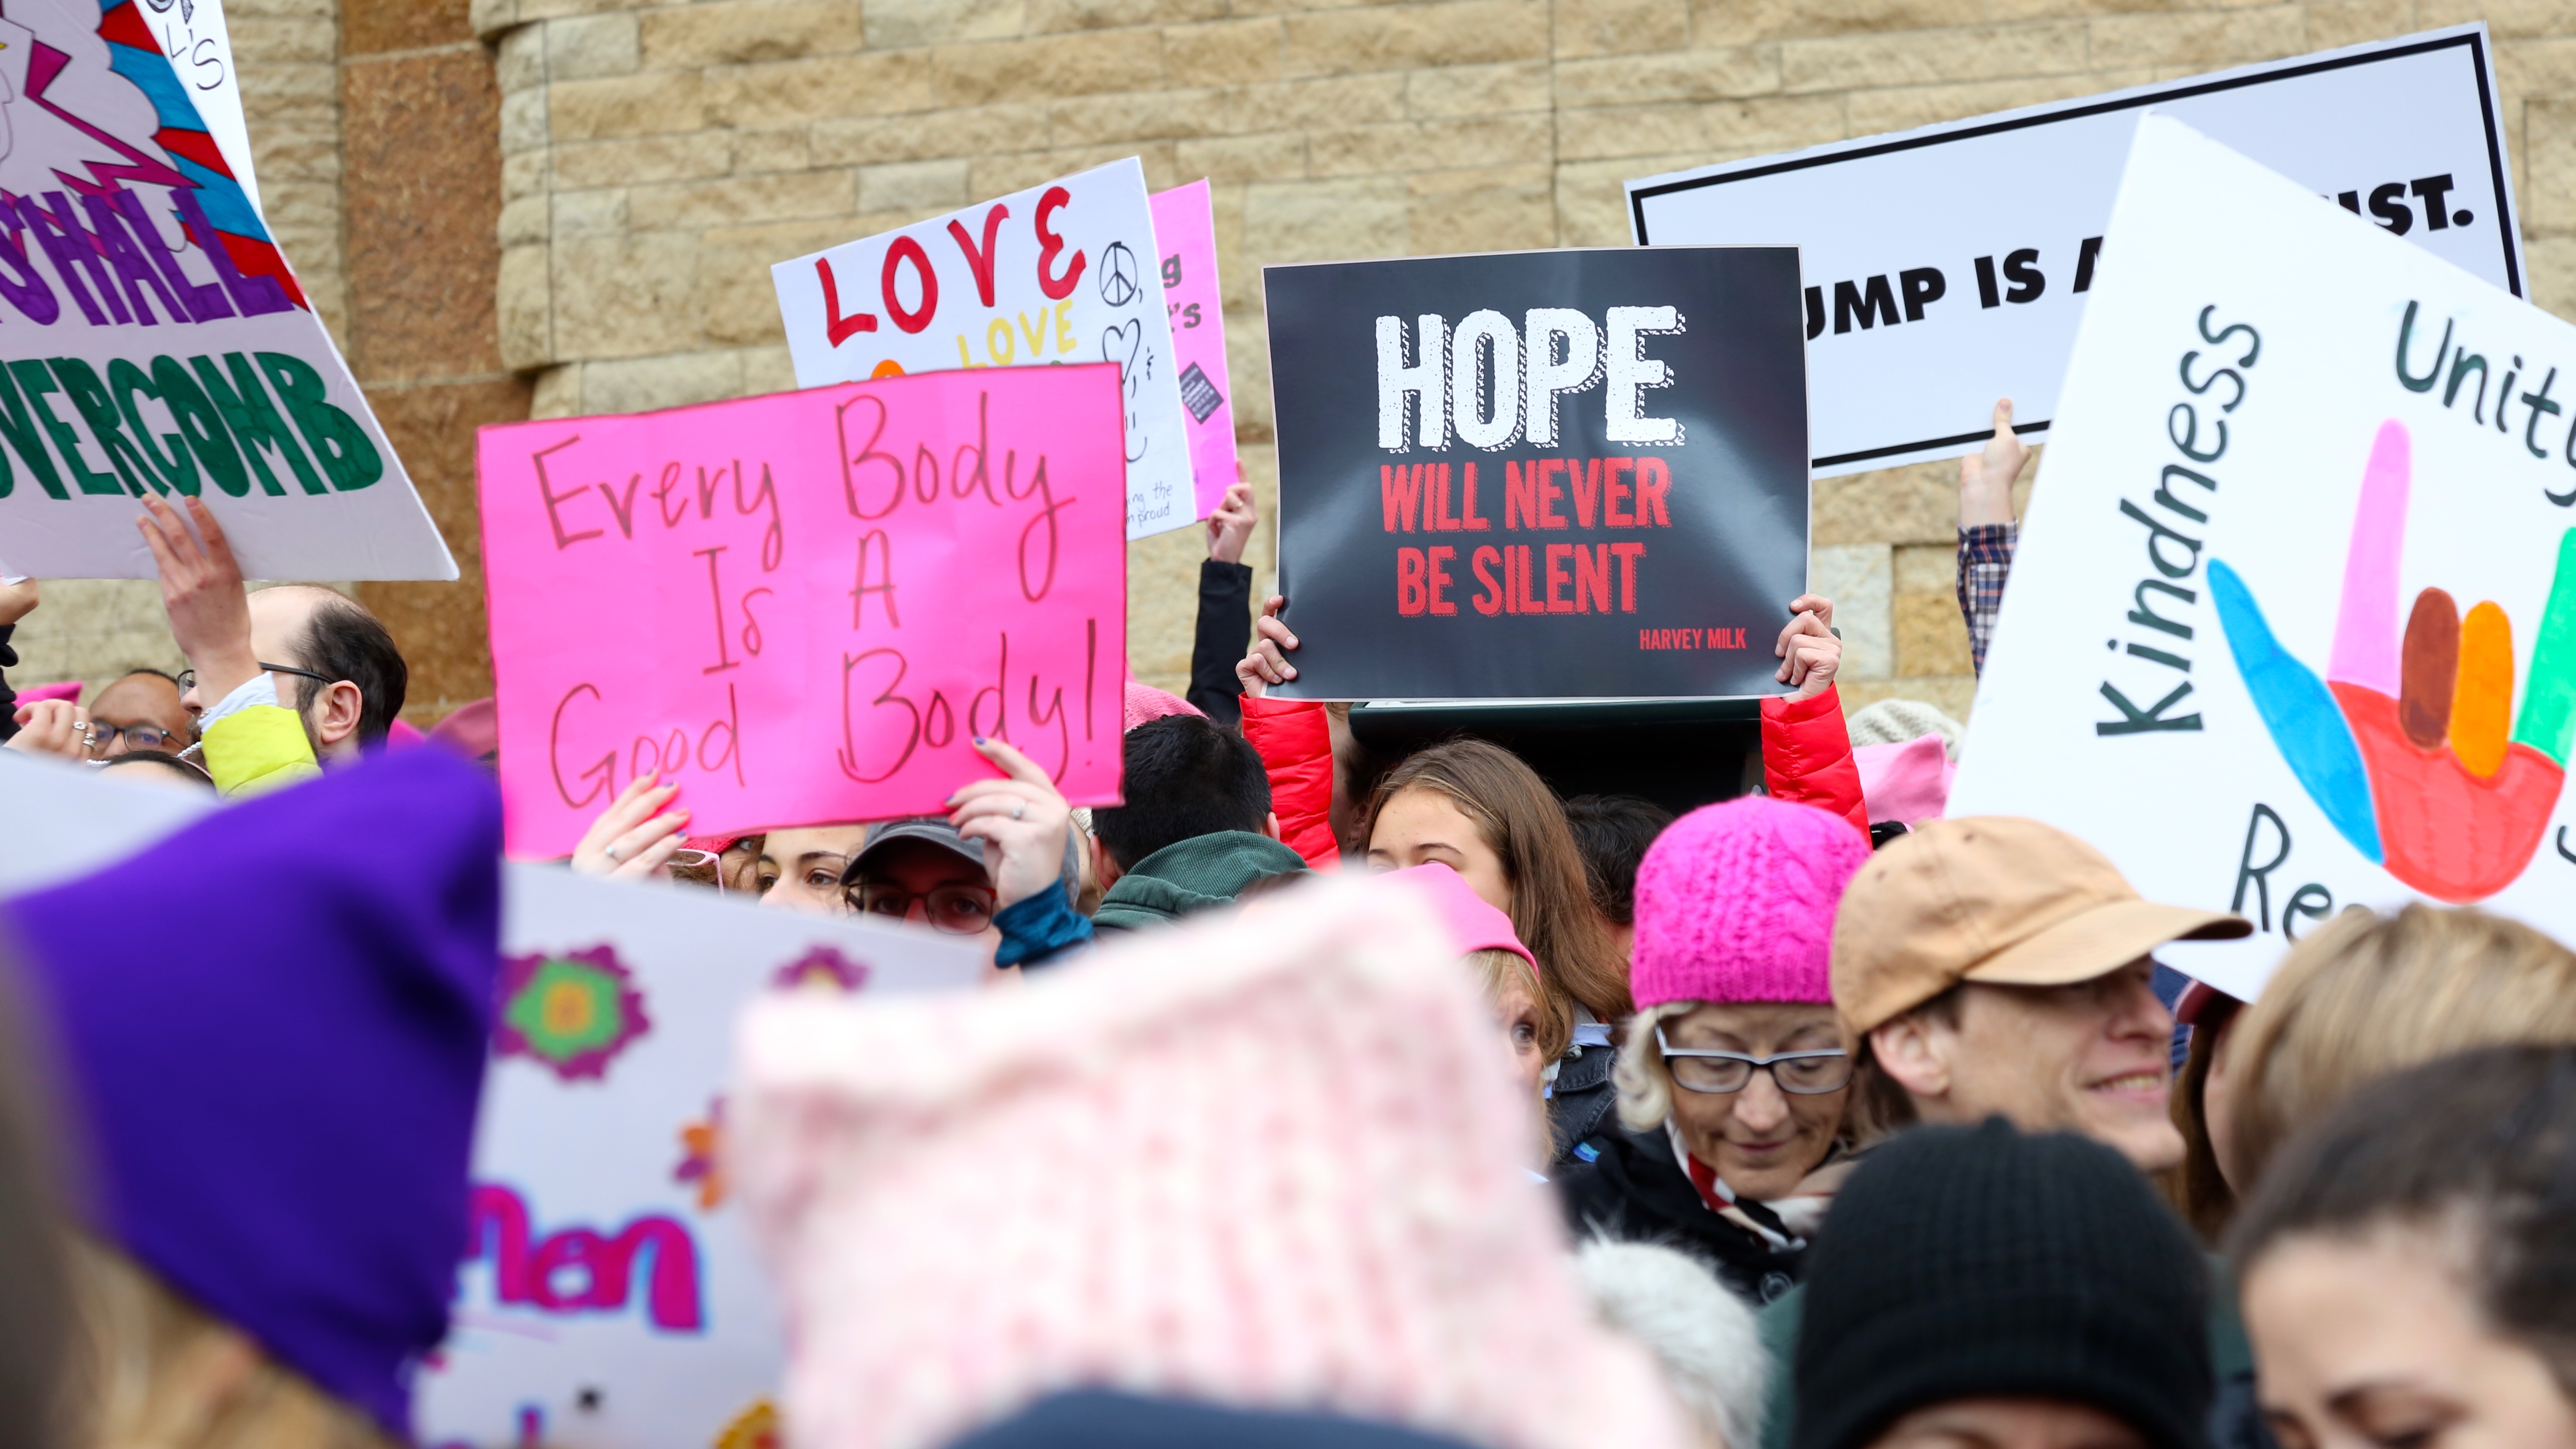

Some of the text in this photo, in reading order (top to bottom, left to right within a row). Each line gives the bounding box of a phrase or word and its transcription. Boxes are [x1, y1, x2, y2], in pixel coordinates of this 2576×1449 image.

[0, 186, 295, 326] SHALL
[815, 186, 1086, 348] LOVE
[1974, 248, 2046, 309] IS
[957, 297, 1077, 368] LOVE
[1375, 305, 1688, 453] HOPE
[0, 352, 383, 500] VERCOMB
[532, 391, 1076, 603] Every Body
[1380, 456, 1674, 534] WILL NEVER
[1397, 541, 1647, 617] BE SILENT
[2096, 304, 2261, 737] Kindness
[693, 529, 900, 676] Is A
[1639, 627, 1746, 650] HARVEY MILK
[550, 618, 1112, 809] Good Body!
[2231, 803, 2374, 948] Re
